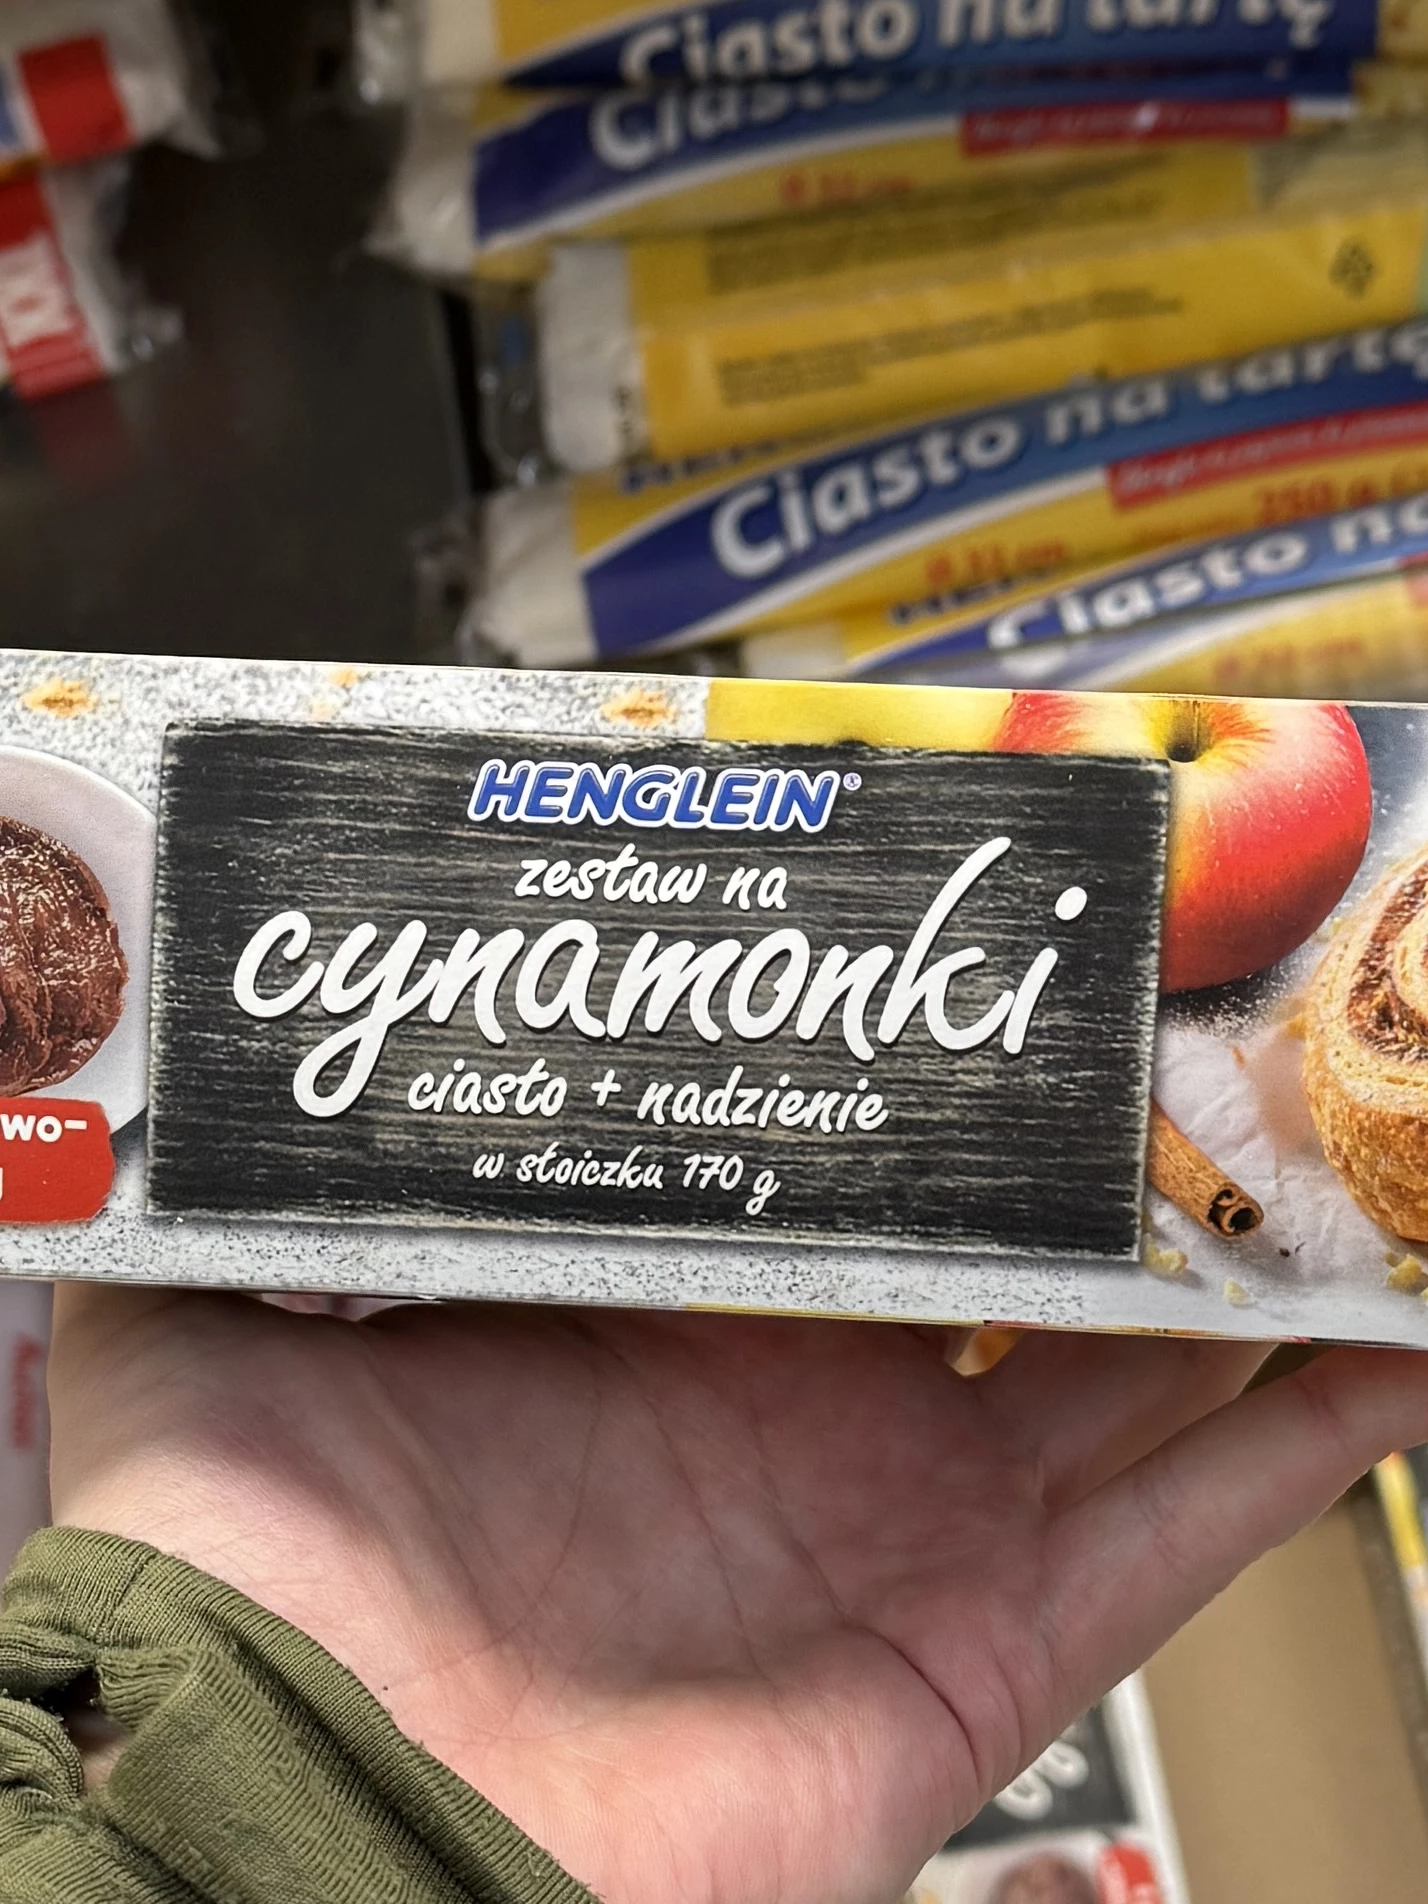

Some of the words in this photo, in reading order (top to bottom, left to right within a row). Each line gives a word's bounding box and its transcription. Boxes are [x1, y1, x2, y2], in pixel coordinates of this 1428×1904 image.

[711, 408, 1025, 581] Ciasto
[1047, 375, 1170, 446] na
[514, 843, 708, 905] zestaw
[726, 857, 788, 911] na
[230, 836, 1088, 1117] cynamonki
[407, 1058, 568, 1119] ciasto
[589, 1073, 622, 1107] +
[636, 1067, 888, 1133] nadzienie
[471, 1153, 504, 1184] w
[516, 1143, 667, 1192] słoiczku
[683, 1153, 744, 1192] 170
[748, 1170, 781, 1217] g
